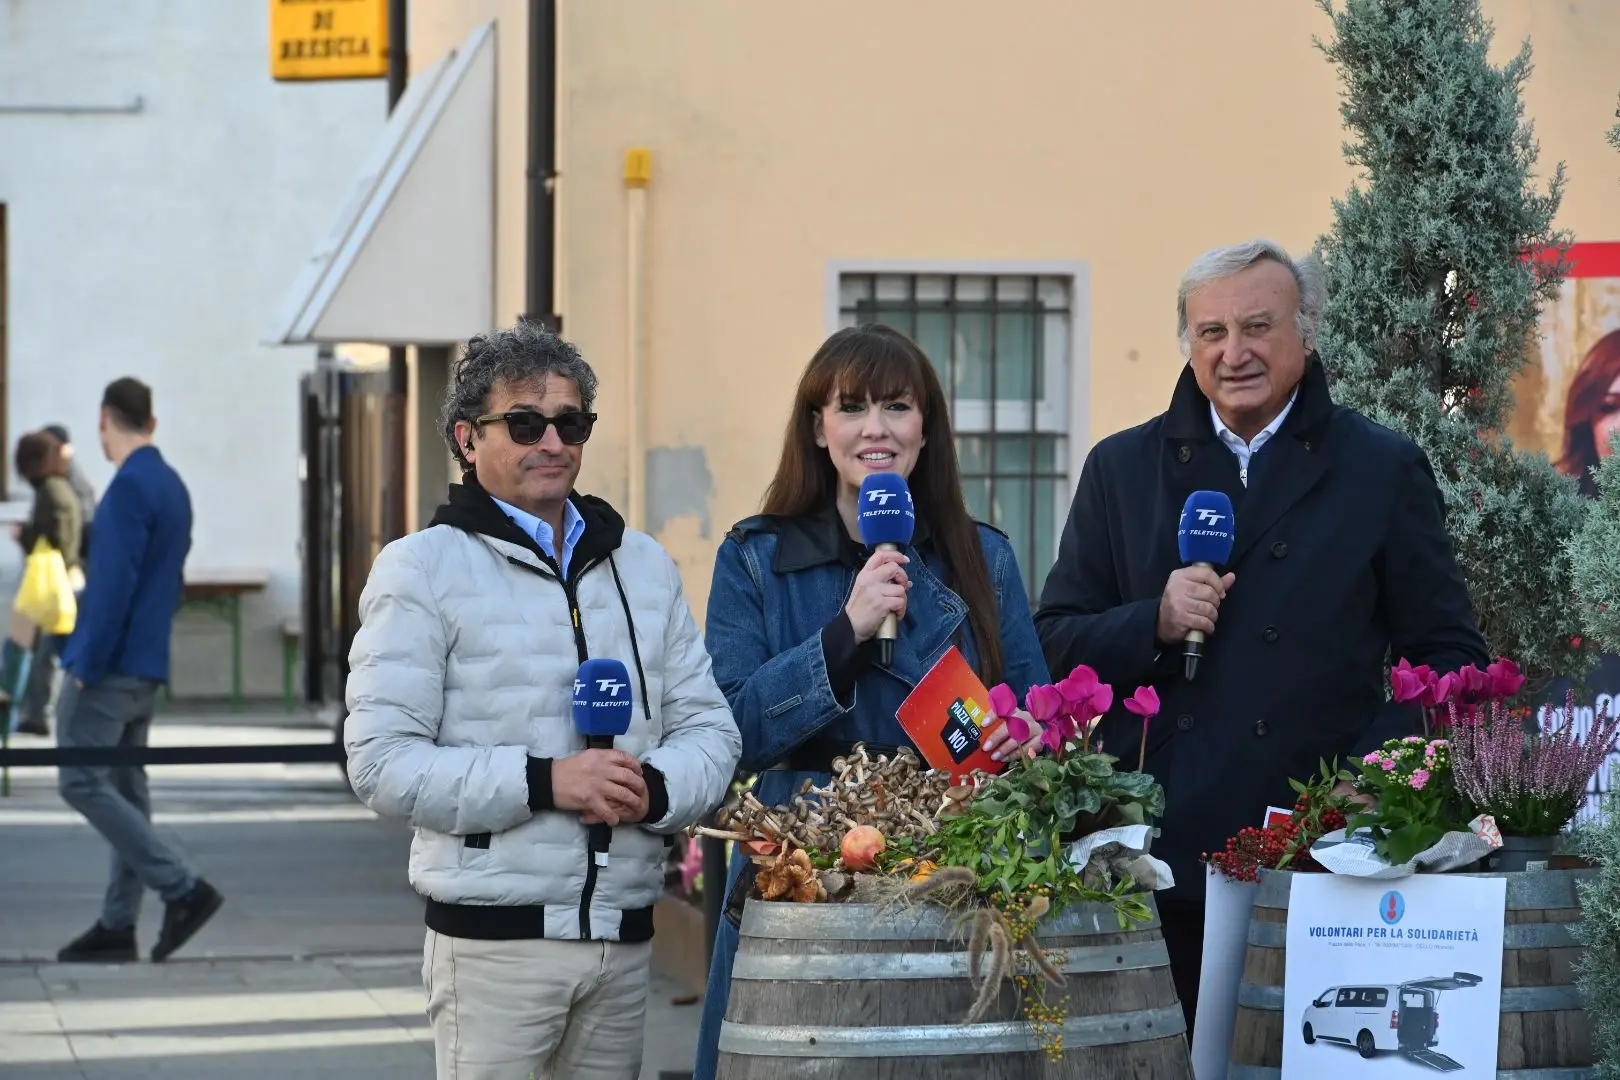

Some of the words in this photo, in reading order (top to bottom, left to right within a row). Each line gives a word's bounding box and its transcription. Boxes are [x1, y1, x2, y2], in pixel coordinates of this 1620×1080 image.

[280, 37, 370, 59] BRESCIA
[863, 509, 900, 518] TELETUTTO
[1189, 529, 1228, 538] TELETUTTO
[950, 701, 971, 726] PIAZZA
[970, 706, 982, 720] IN
[948, 728, 969, 753] NOI
[1309, 926, 1363, 938] VOLONTARI
[1367, 927, 1387, 938] PER
[1390, 928, 1403, 939] LA
[1407, 928, 1479, 942] SOLIDARIETÀ
